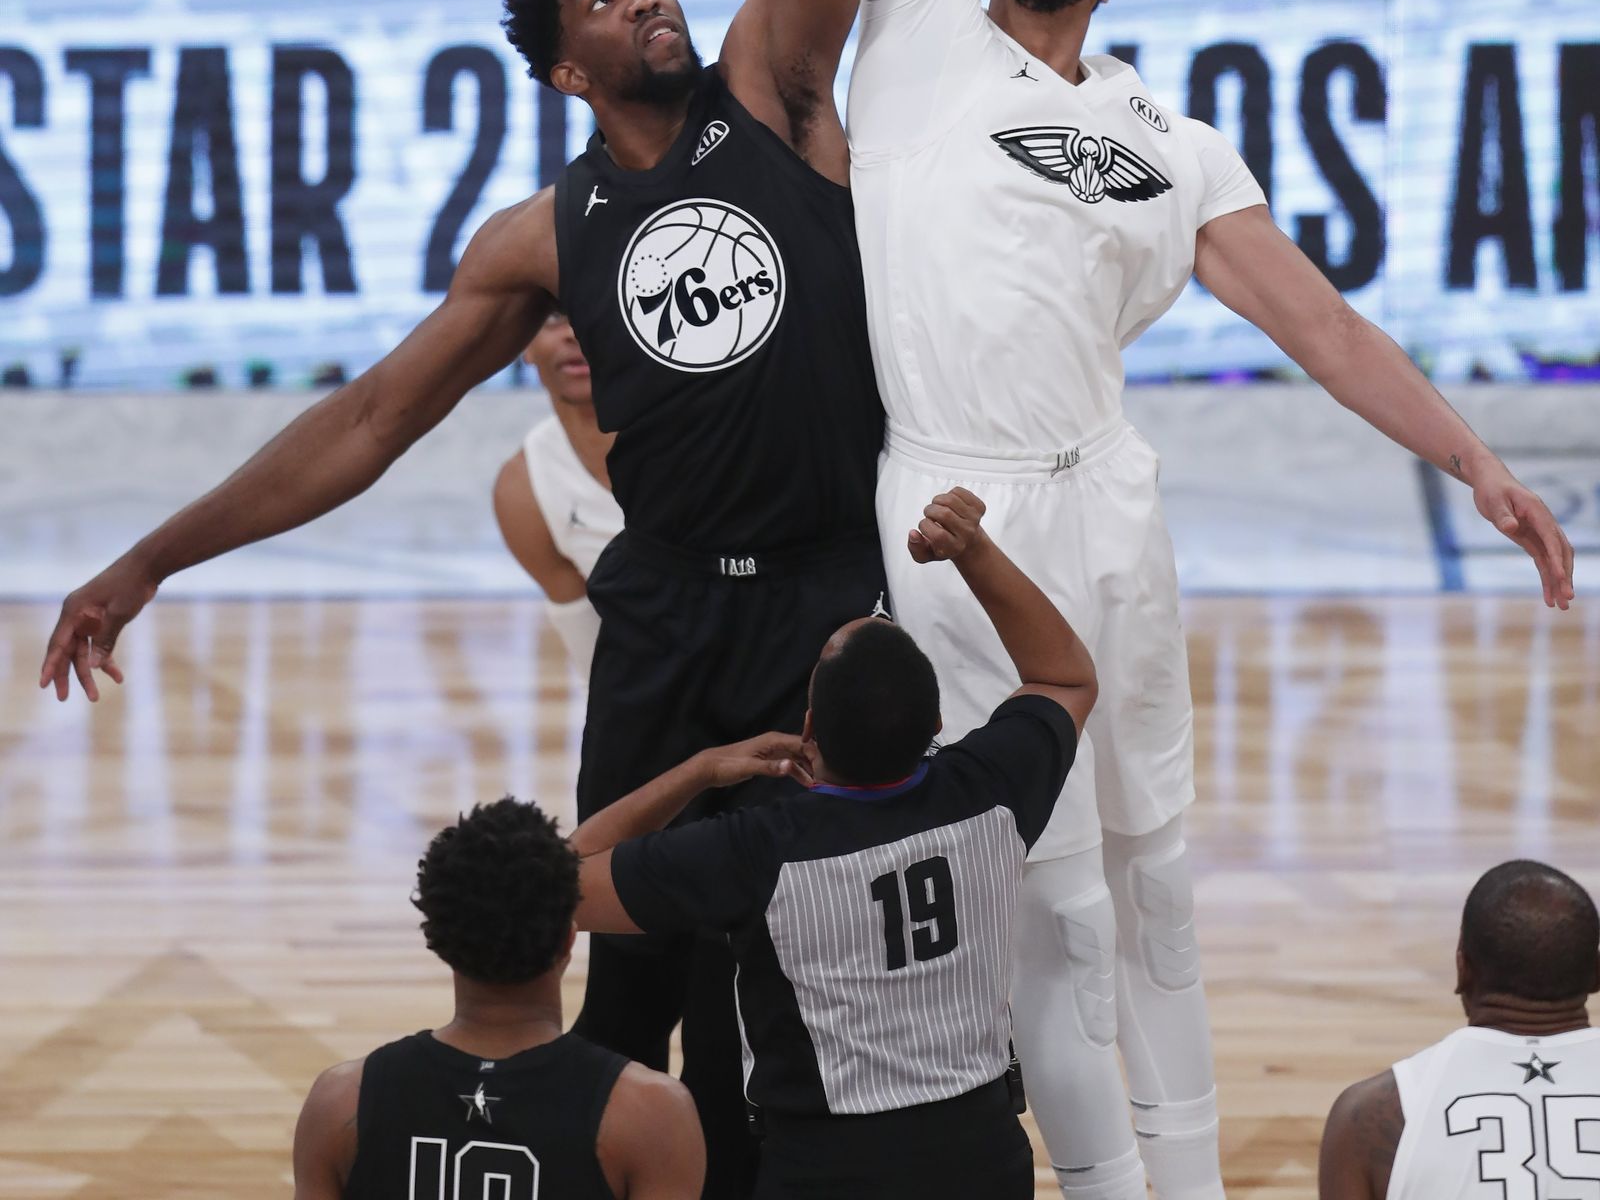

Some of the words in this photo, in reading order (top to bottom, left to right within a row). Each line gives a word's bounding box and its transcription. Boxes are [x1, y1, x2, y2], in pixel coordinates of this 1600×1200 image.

[694, 125, 725, 159] KIA
[1136, 100, 1163, 131] KIA
[635, 266, 775, 349] 76ers
[870, 854, 959, 972] 19
